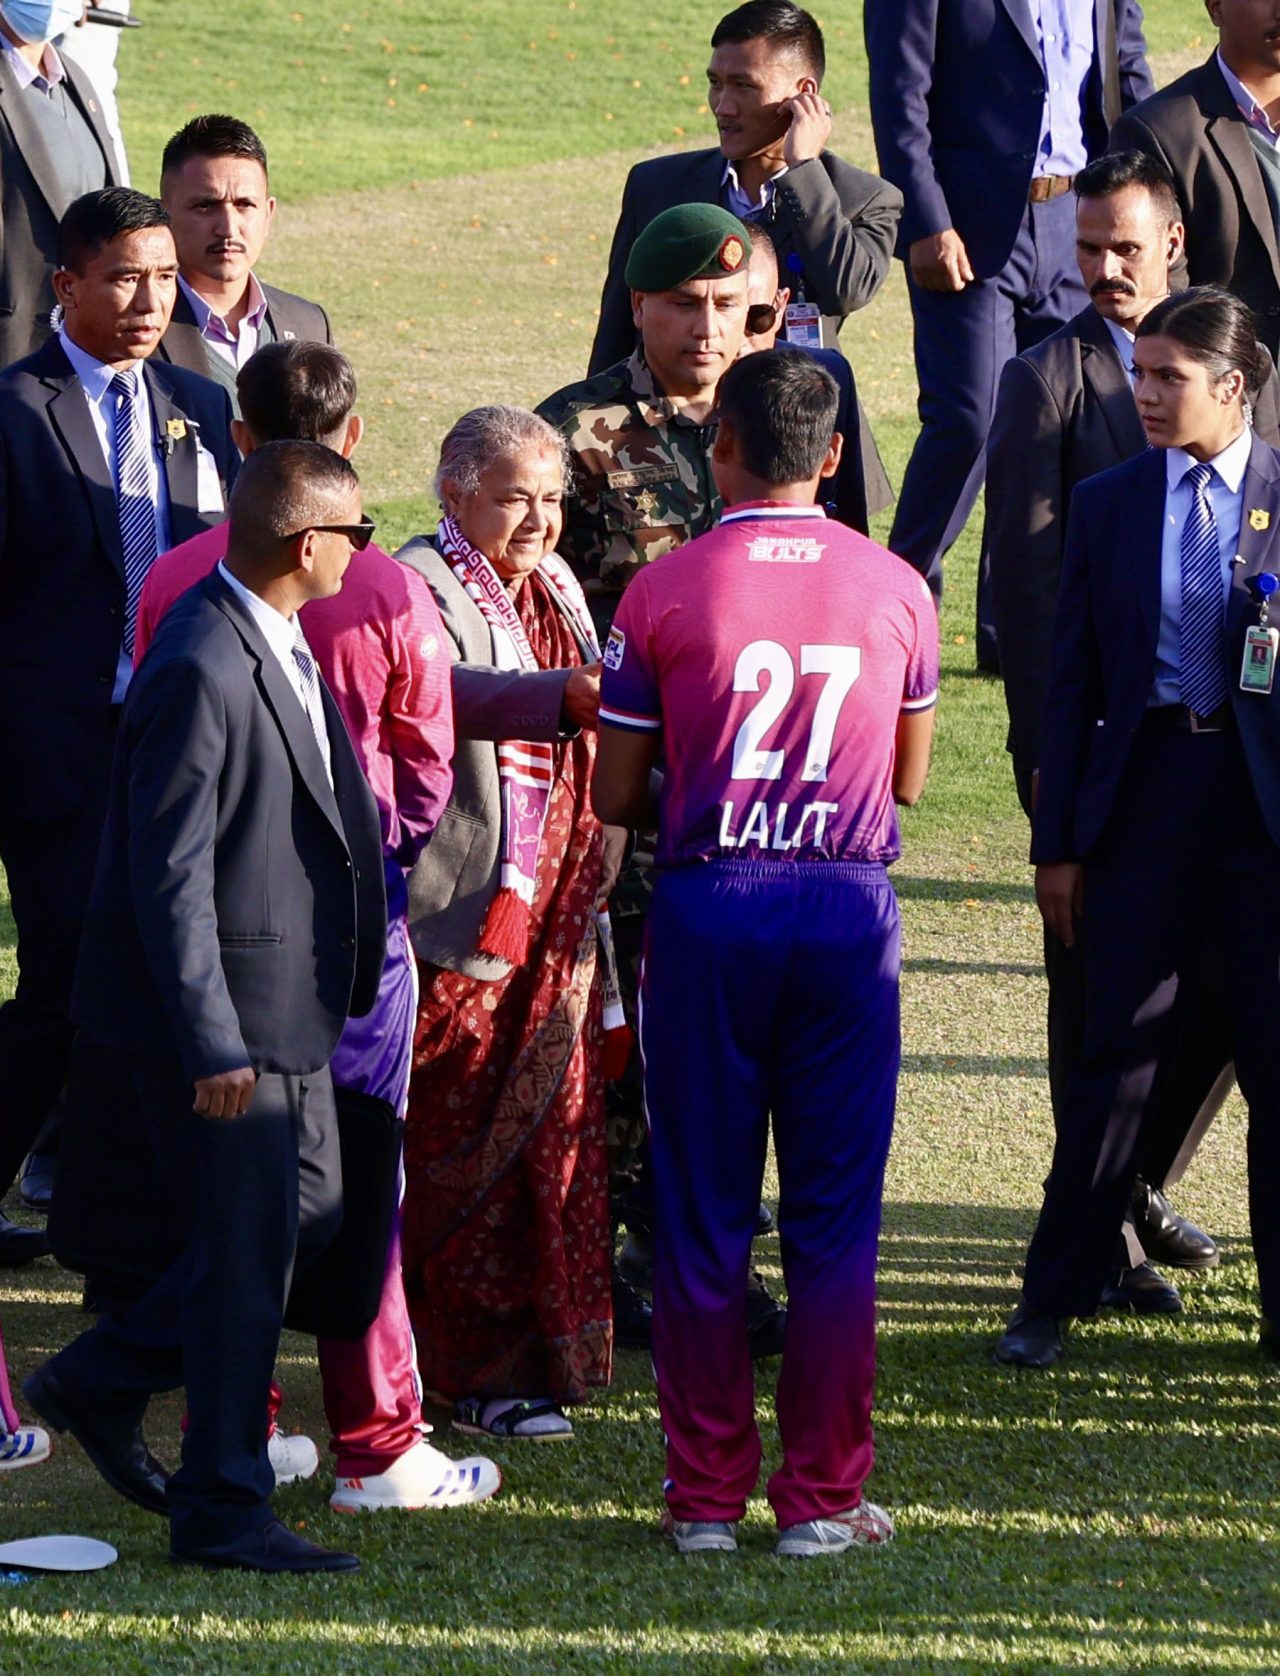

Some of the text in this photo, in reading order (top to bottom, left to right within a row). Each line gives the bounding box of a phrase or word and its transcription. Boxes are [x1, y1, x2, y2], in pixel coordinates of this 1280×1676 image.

[751, 546, 822, 561] BOLTS
[730, 638, 862, 783] 27
[718, 800, 840, 851] LALIT
